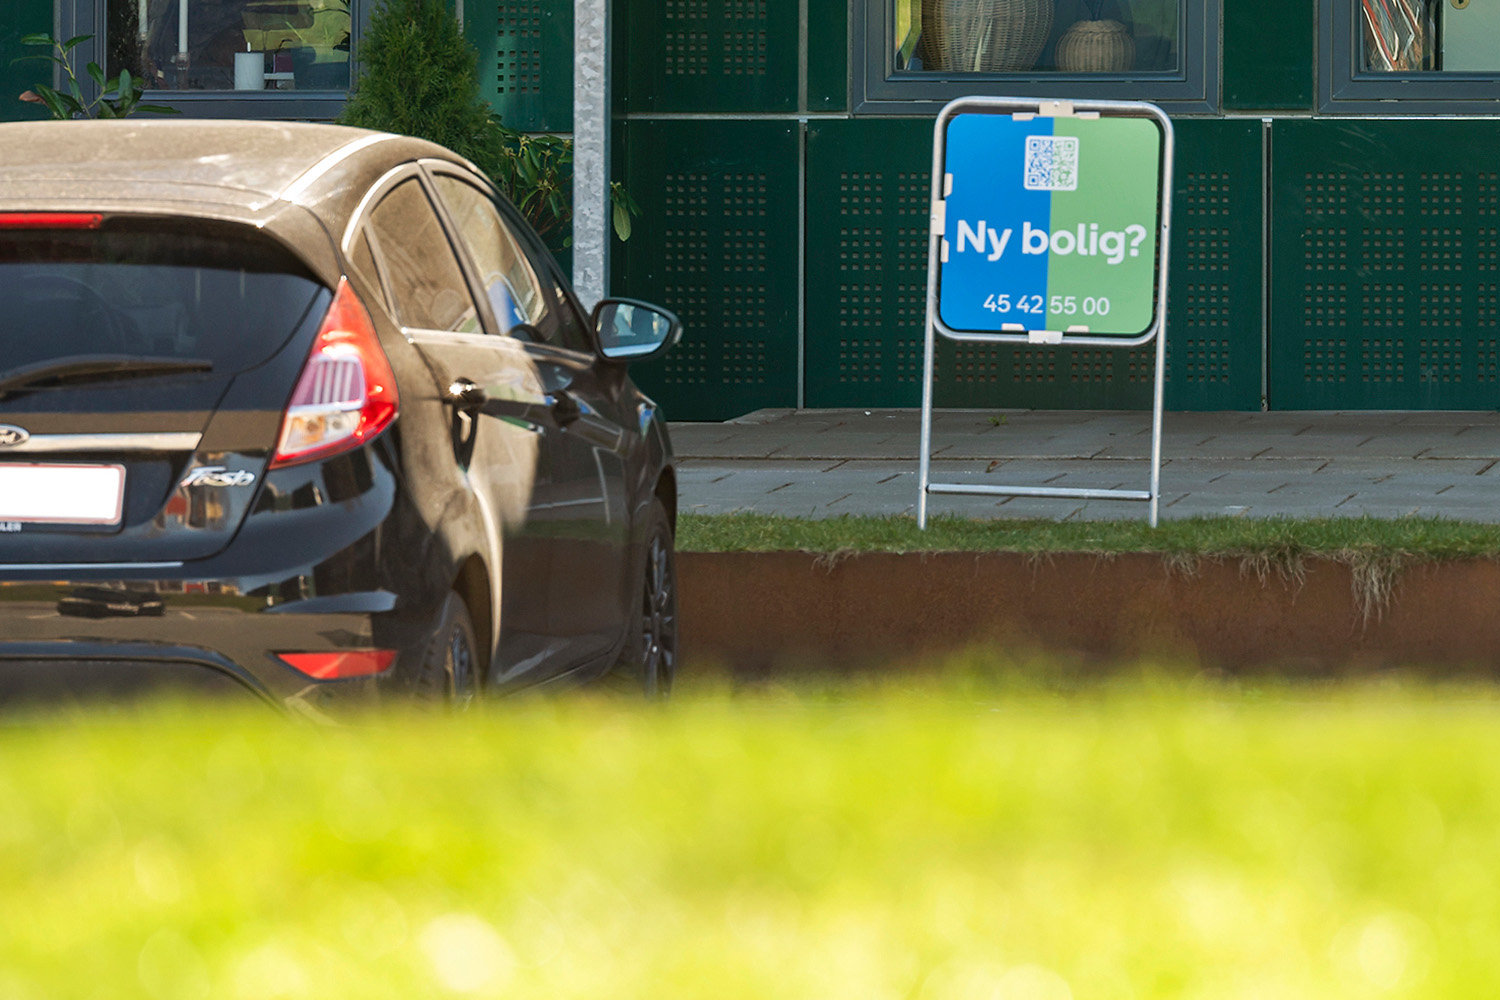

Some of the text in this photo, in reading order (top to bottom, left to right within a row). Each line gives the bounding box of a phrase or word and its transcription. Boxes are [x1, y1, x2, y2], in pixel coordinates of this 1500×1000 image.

[957, 219, 1147, 265] Ny bolig?
[983, 294, 1110, 316] 45 42 55 00
